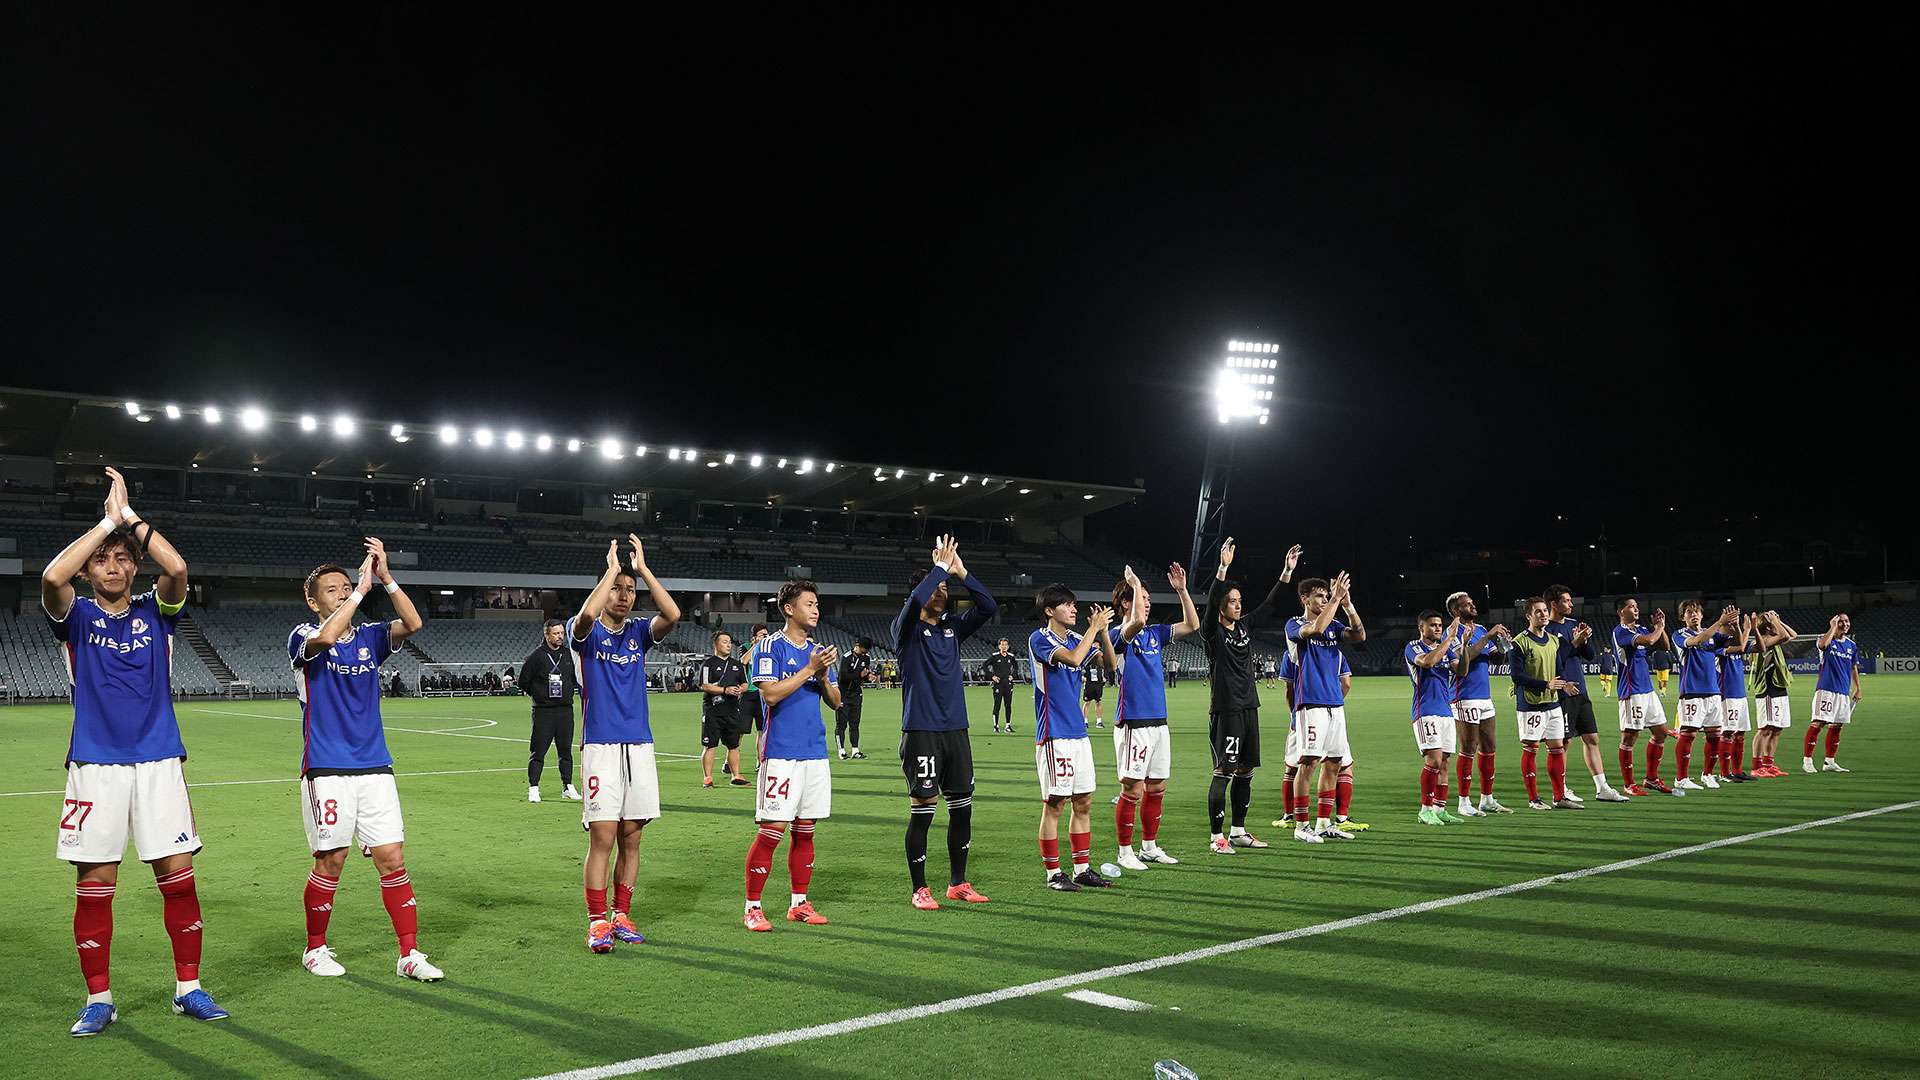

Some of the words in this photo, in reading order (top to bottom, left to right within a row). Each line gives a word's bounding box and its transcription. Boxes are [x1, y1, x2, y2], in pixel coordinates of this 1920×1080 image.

[1884, 660, 1920, 671] NEO
[1632, 706, 1643, 719] 15
[1685, 704, 1698, 716] 39
[1774, 705, 1780, 717] 2
[1820, 700, 1833, 712] 20
[1465, 707, 1479, 721] 10
[1527, 715, 1541, 728] 49
[1728, 709, 1739, 721] 28
[1308, 726, 1317, 742] 5
[1424, 721, 1438, 736] 11
[1225, 736, 1240, 755] 21
[1132, 745, 1148, 763] 14
[917, 756, 937, 778] 31
[1056, 758, 1074, 777] 35
[588, 776, 600, 800] 9
[765, 776, 790, 800] 24
[60, 799, 93, 831] 27
